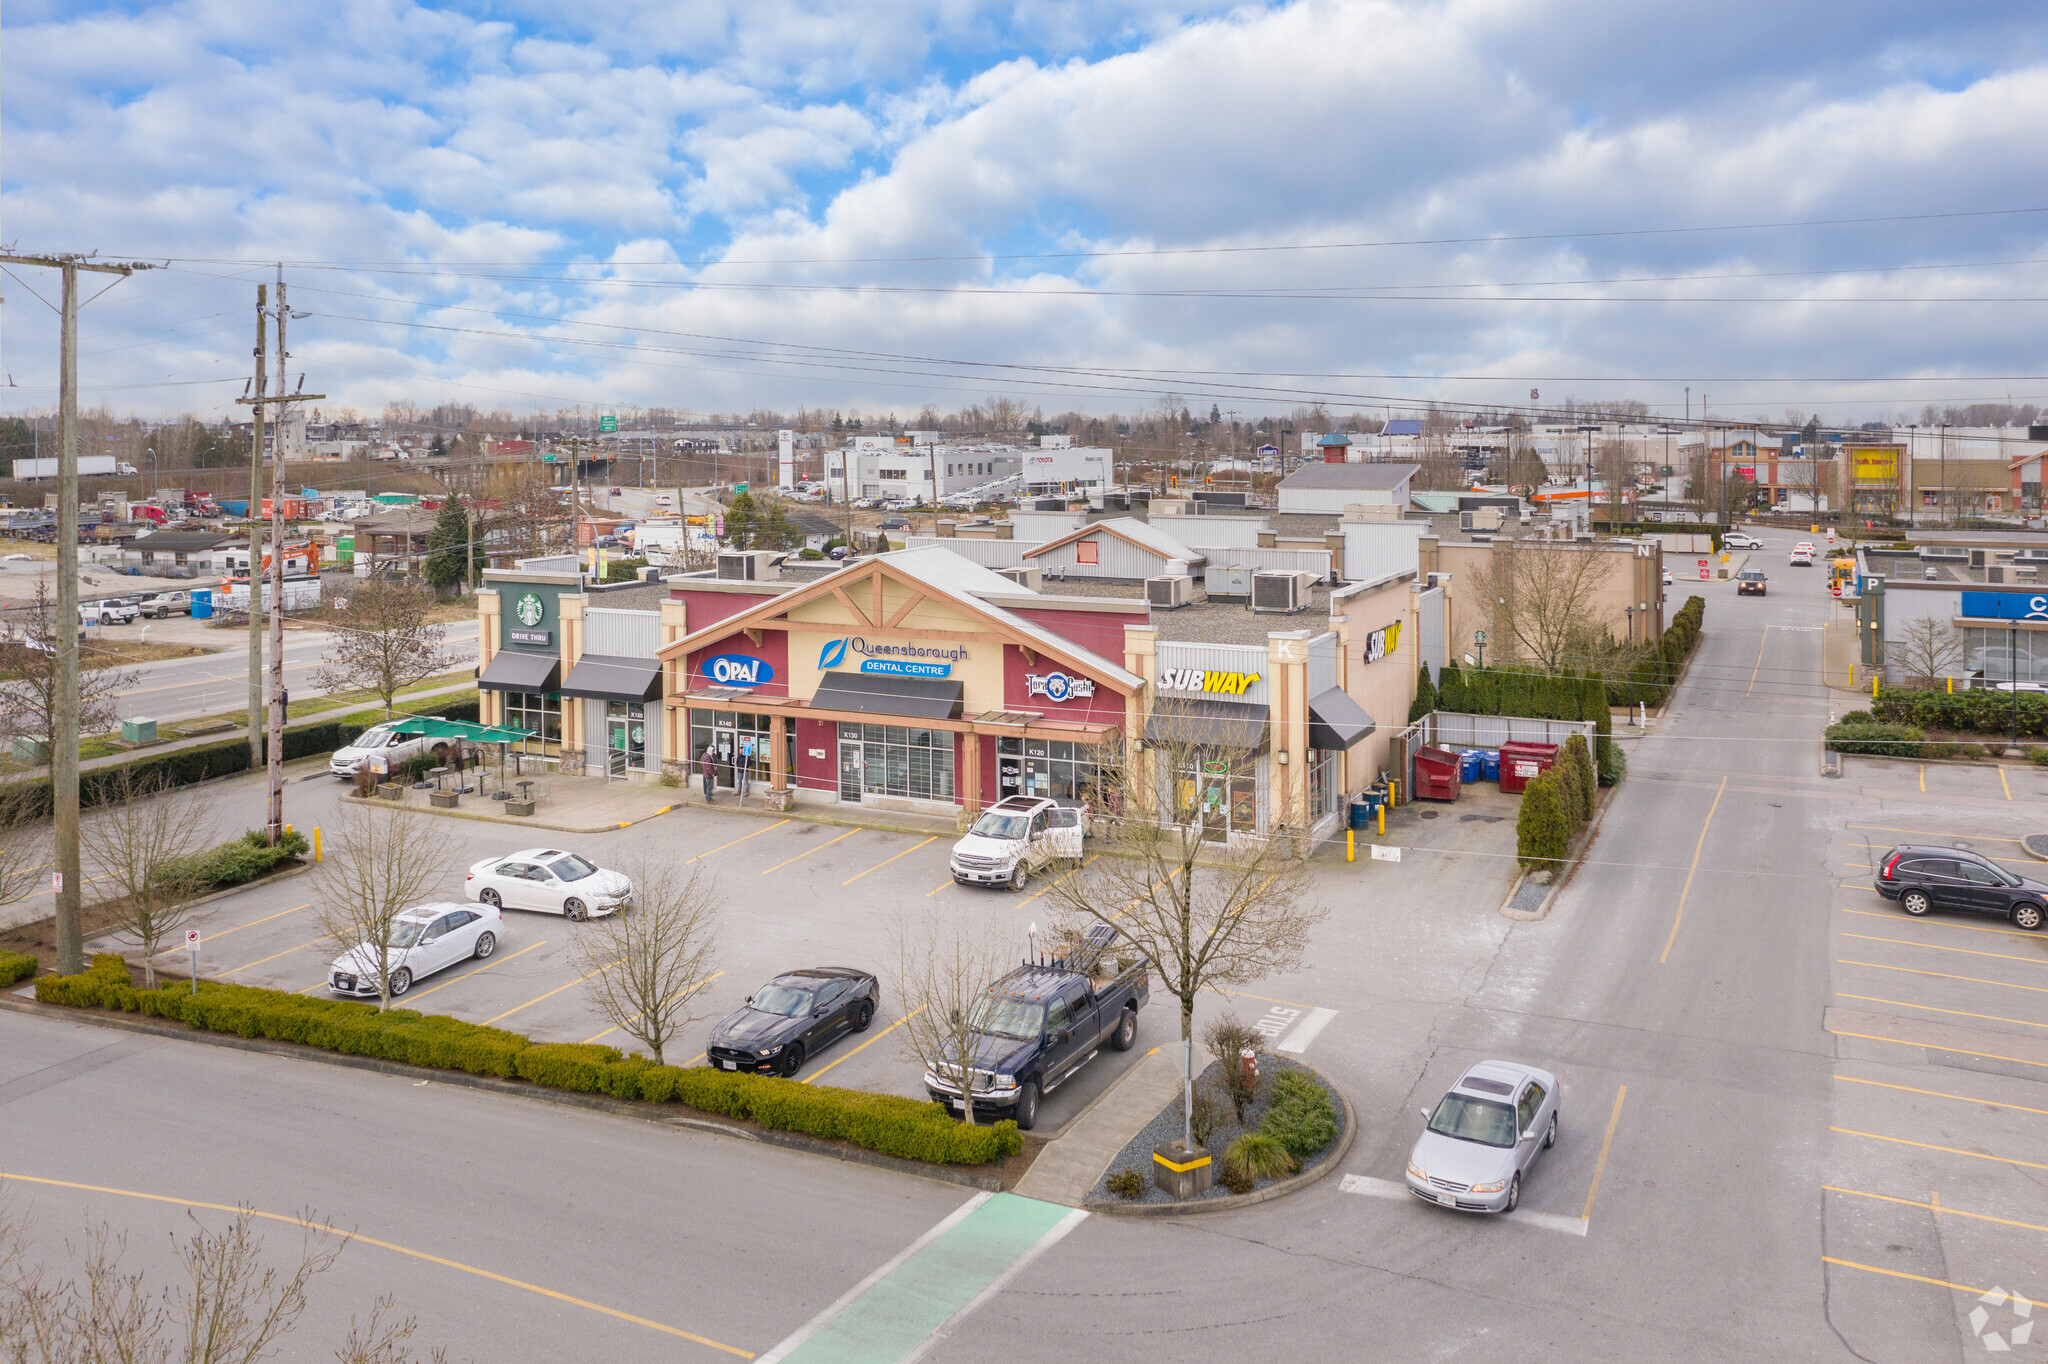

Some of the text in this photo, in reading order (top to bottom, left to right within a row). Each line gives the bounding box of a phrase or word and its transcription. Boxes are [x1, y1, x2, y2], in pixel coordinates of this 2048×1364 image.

[1638, 544, 1650, 557] N
[1867, 578, 1879, 590] P
[511, 633, 547, 642] DRIVE THRU
[1367, 621, 1402, 662] SUBWAY
[851, 636, 969, 662] Queensborough
[1277, 640, 1293, 659] K
[713, 658, 760, 683] OPA!
[866, 661, 944, 676] DENTAL CENTRE
[1026, 676, 1092, 697] Tora Sushi
[1157, 668, 1262, 696] SUBWAY
[631, 711, 644, 719] K150
[718, 720, 732, 728] K140
[1252, 1006, 1302, 1037] STOP
